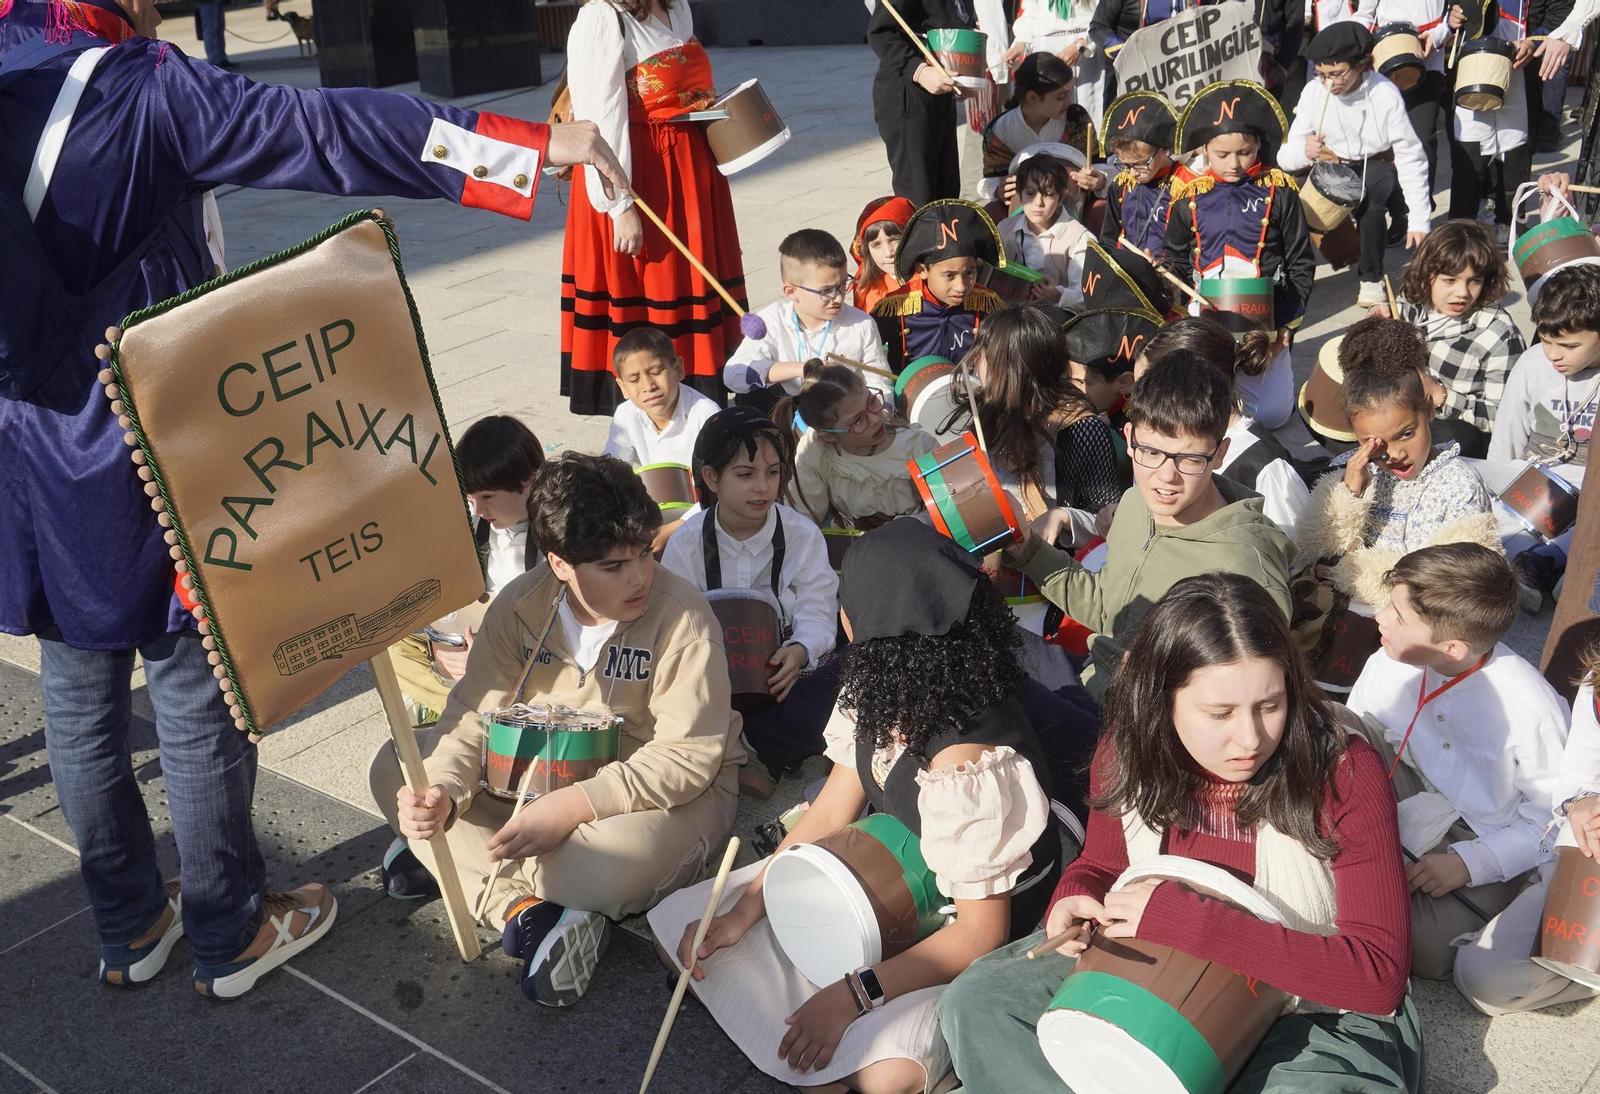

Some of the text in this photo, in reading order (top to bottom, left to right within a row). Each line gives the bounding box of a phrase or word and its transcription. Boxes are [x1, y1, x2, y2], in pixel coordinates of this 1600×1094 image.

[1160, 8, 1221, 56] CEIP
[1125, 21, 1260, 93] PLURILINGÜE
[1117, 105, 1146, 130] N
[1213, 97, 1241, 126] N
[1241, 197, 1264, 213] N
[937, 218, 959, 250] N
[1082, 270, 1101, 297] N
[950, 329, 970, 351] N
[1107, 334, 1144, 363] N
[217, 318, 355, 417] CEIP
[202, 398, 441, 572] PARAIXAL
[299, 521, 384, 583] TEIS
[725, 626, 772, 645] CEIP
[604, 645, 652, 681] NYC
